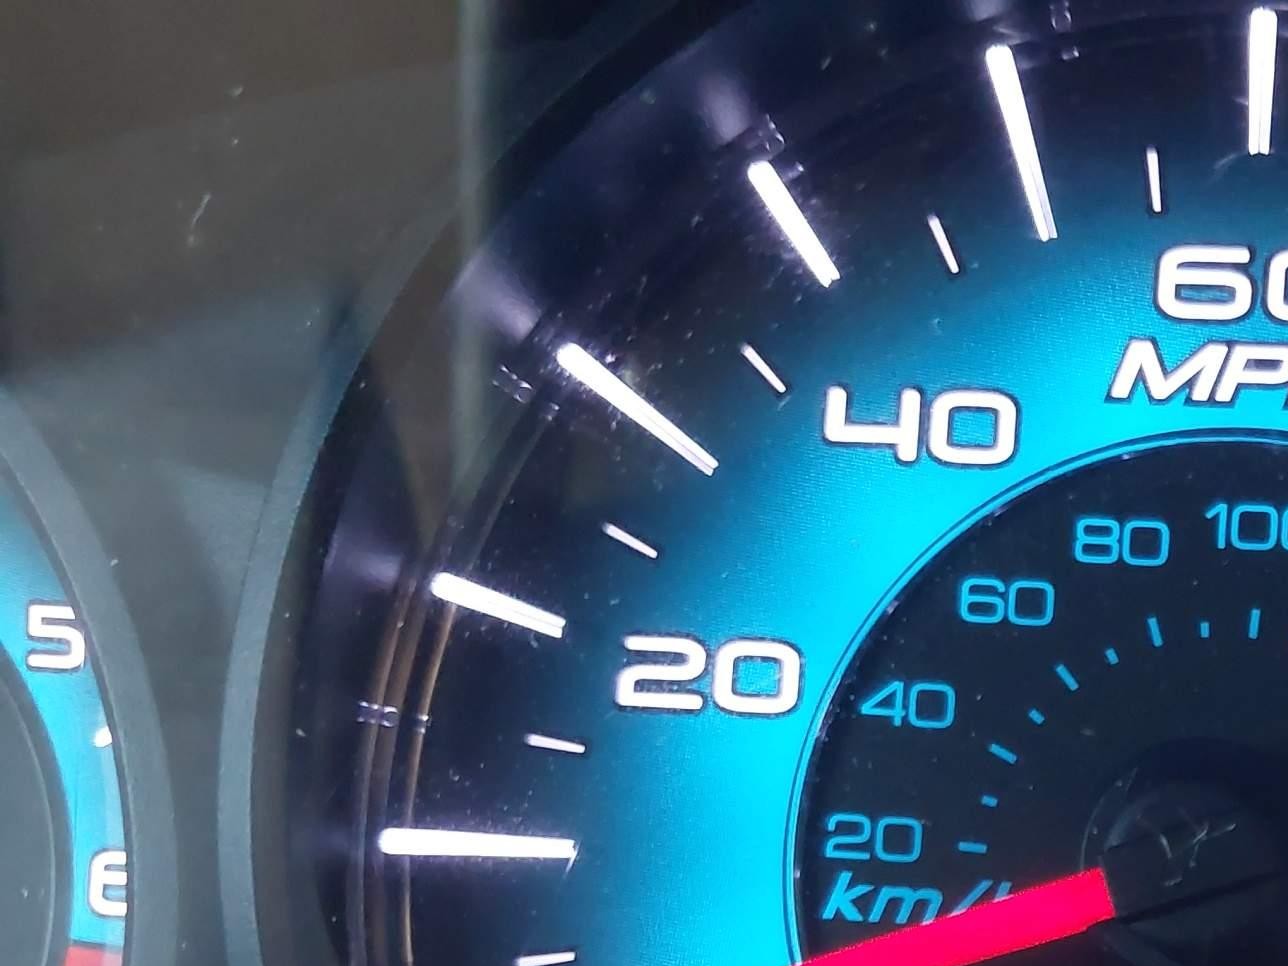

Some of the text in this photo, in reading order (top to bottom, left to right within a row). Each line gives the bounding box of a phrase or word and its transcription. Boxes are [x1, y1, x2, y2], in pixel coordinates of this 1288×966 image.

[824, 387, 1018, 464] 40
[1074, 518, 1169, 566] 80
[958, 578, 1055, 625] 60
[26, 604, 86, 670] 5
[614, 635, 800, 713] 20
[860, 682, 955, 728] 40
[823, 813, 922, 863] 20
[821, 871, 1013, 925] km/
